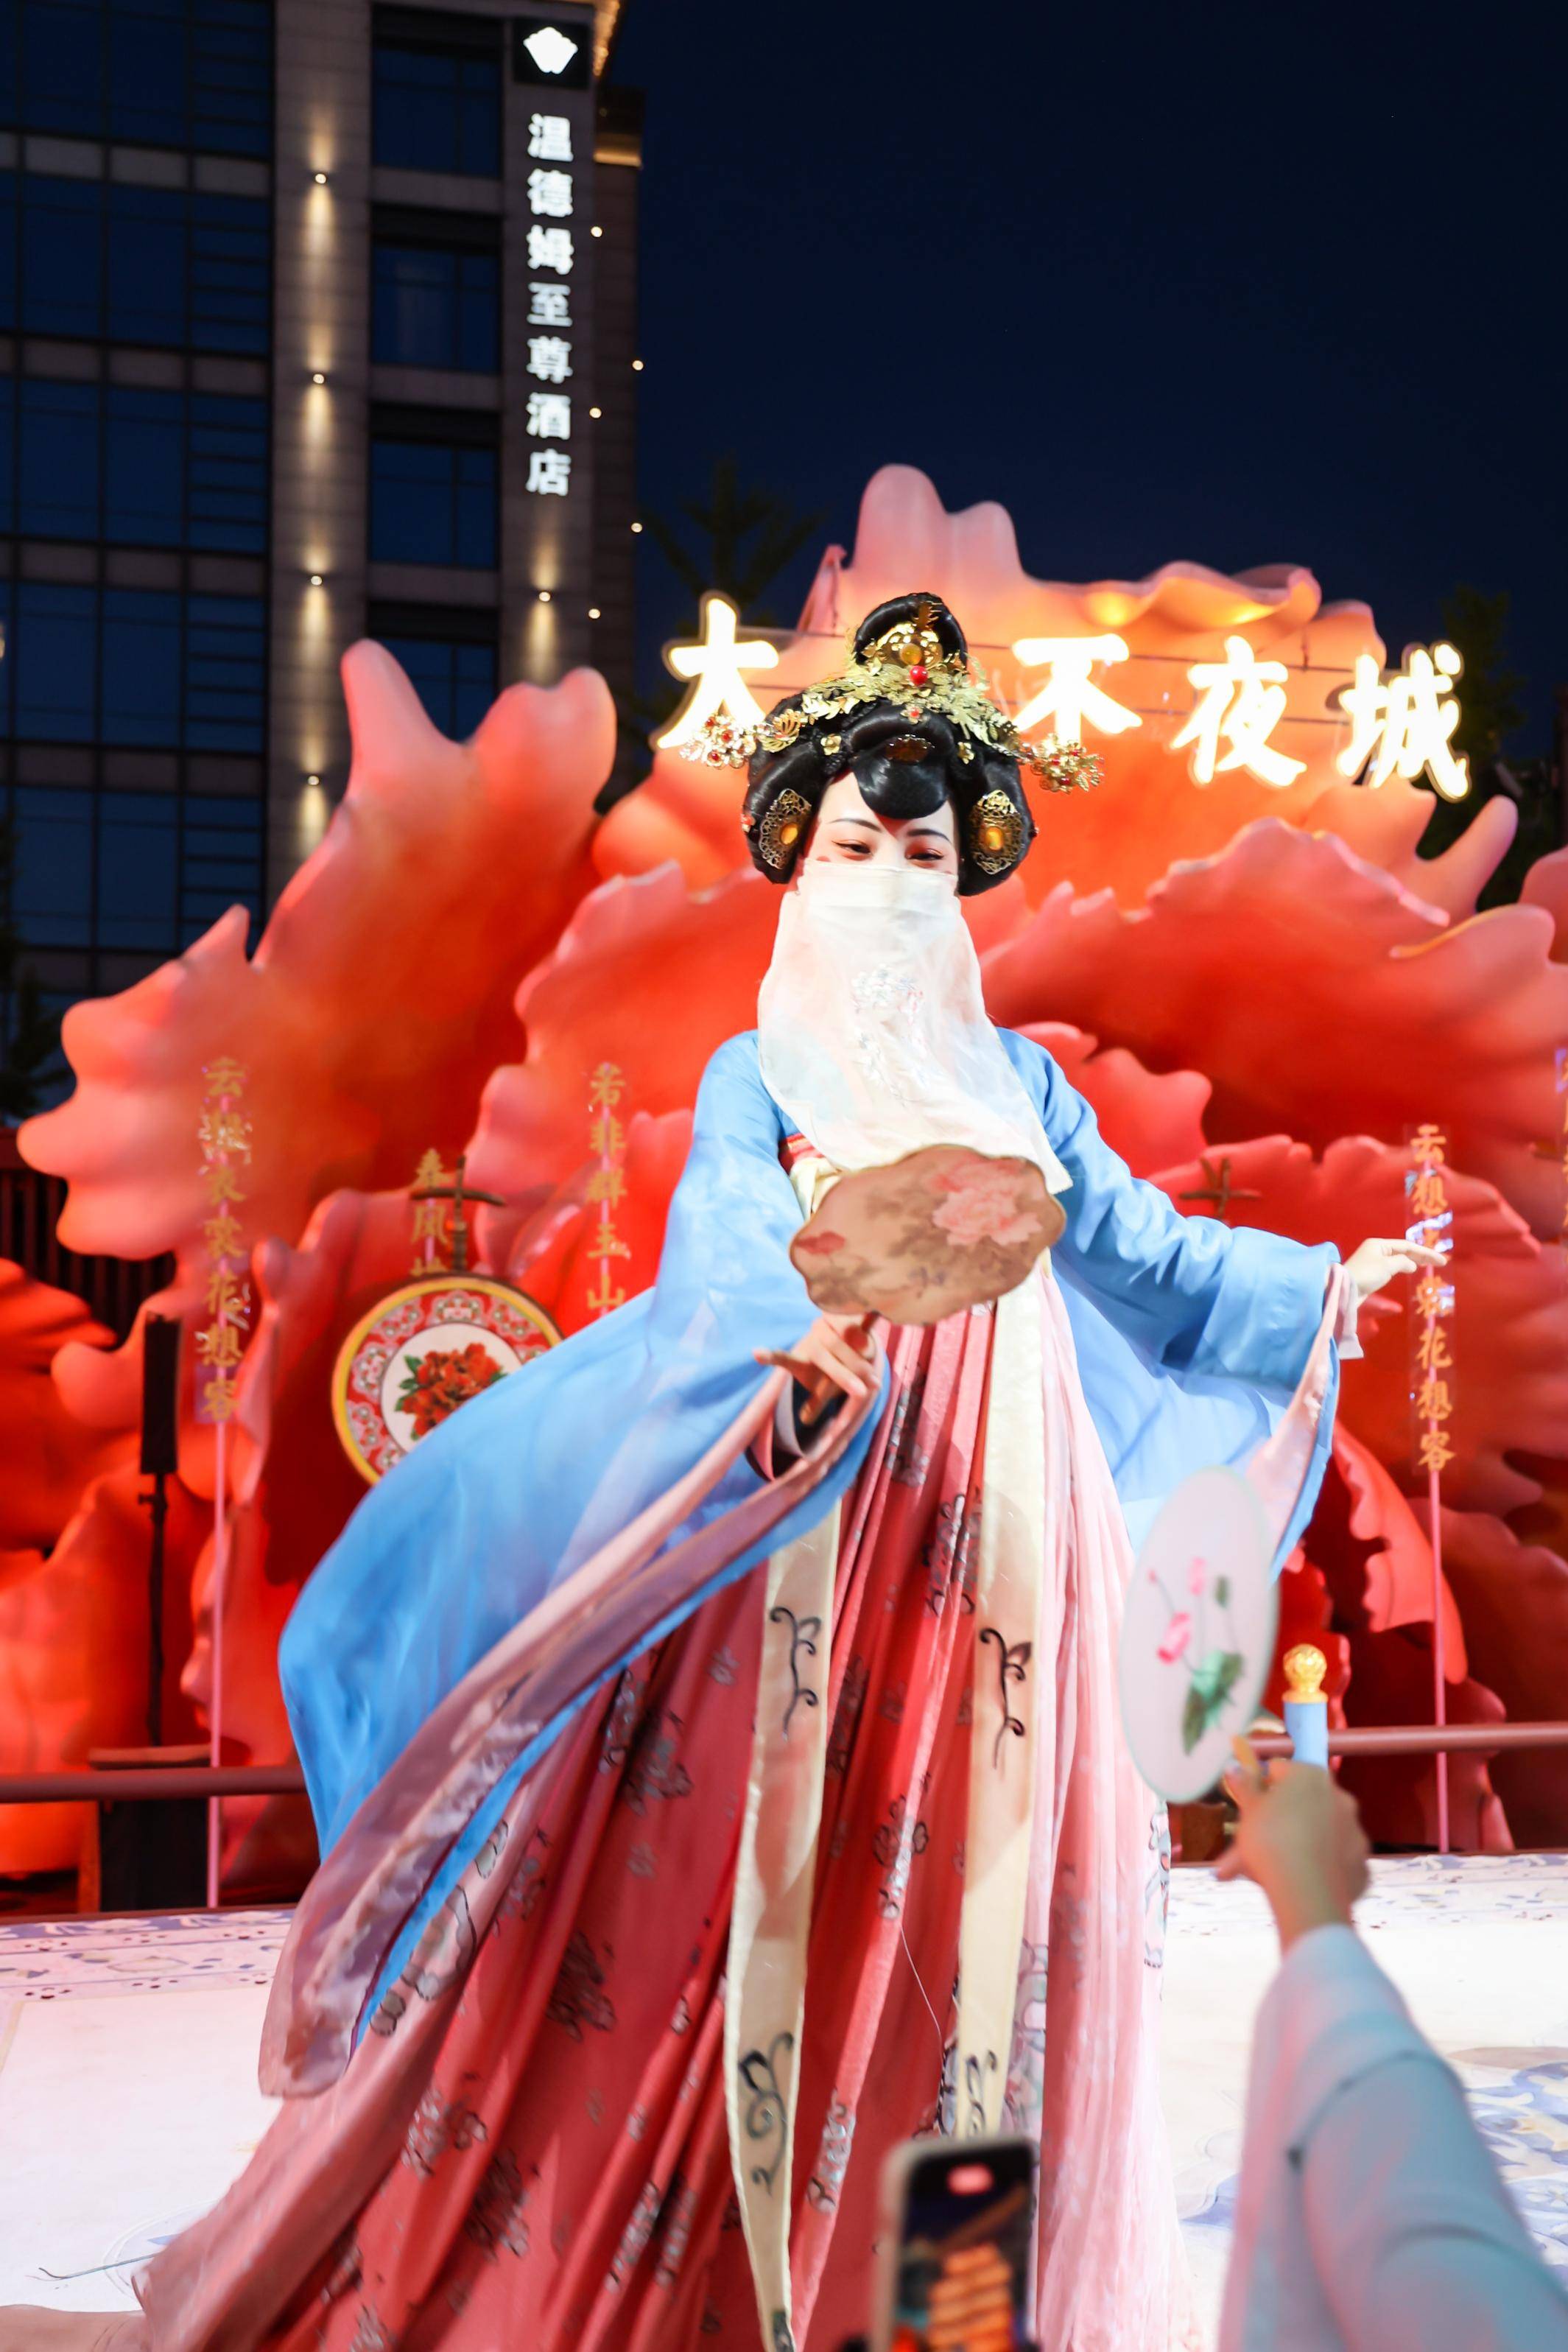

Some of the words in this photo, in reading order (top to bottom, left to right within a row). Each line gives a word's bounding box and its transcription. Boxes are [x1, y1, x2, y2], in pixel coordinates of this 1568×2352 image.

[527, 113, 573, 496] 温德姆至尊酒店
[658, 598, 1470, 800] 大不夜城
[1410, 1124, 1455, 1472] 云想裳花想容
